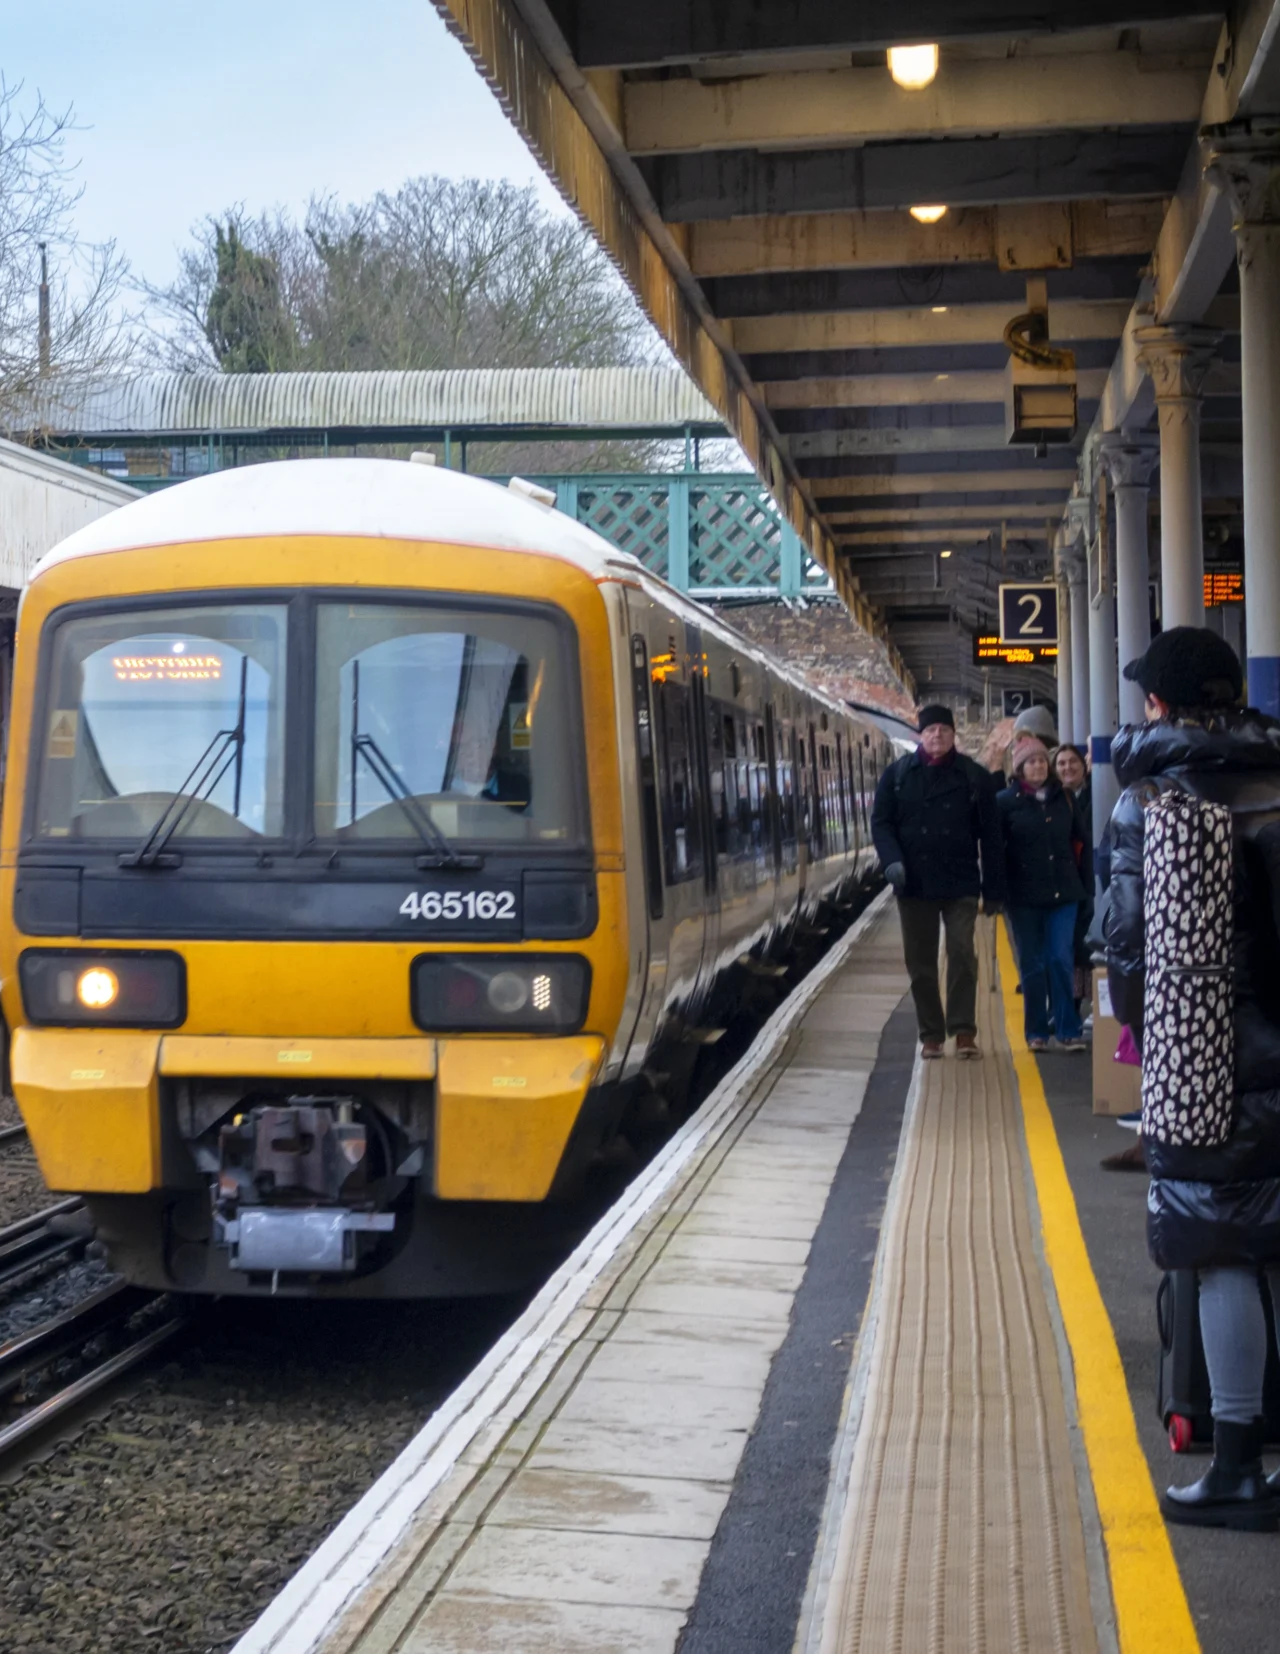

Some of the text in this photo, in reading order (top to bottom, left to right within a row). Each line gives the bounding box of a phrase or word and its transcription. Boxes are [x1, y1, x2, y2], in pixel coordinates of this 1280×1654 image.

[1017, 593, 1044, 634] 2
[1010, 693, 1024, 714] 2
[399, 890, 516, 920] 465162
